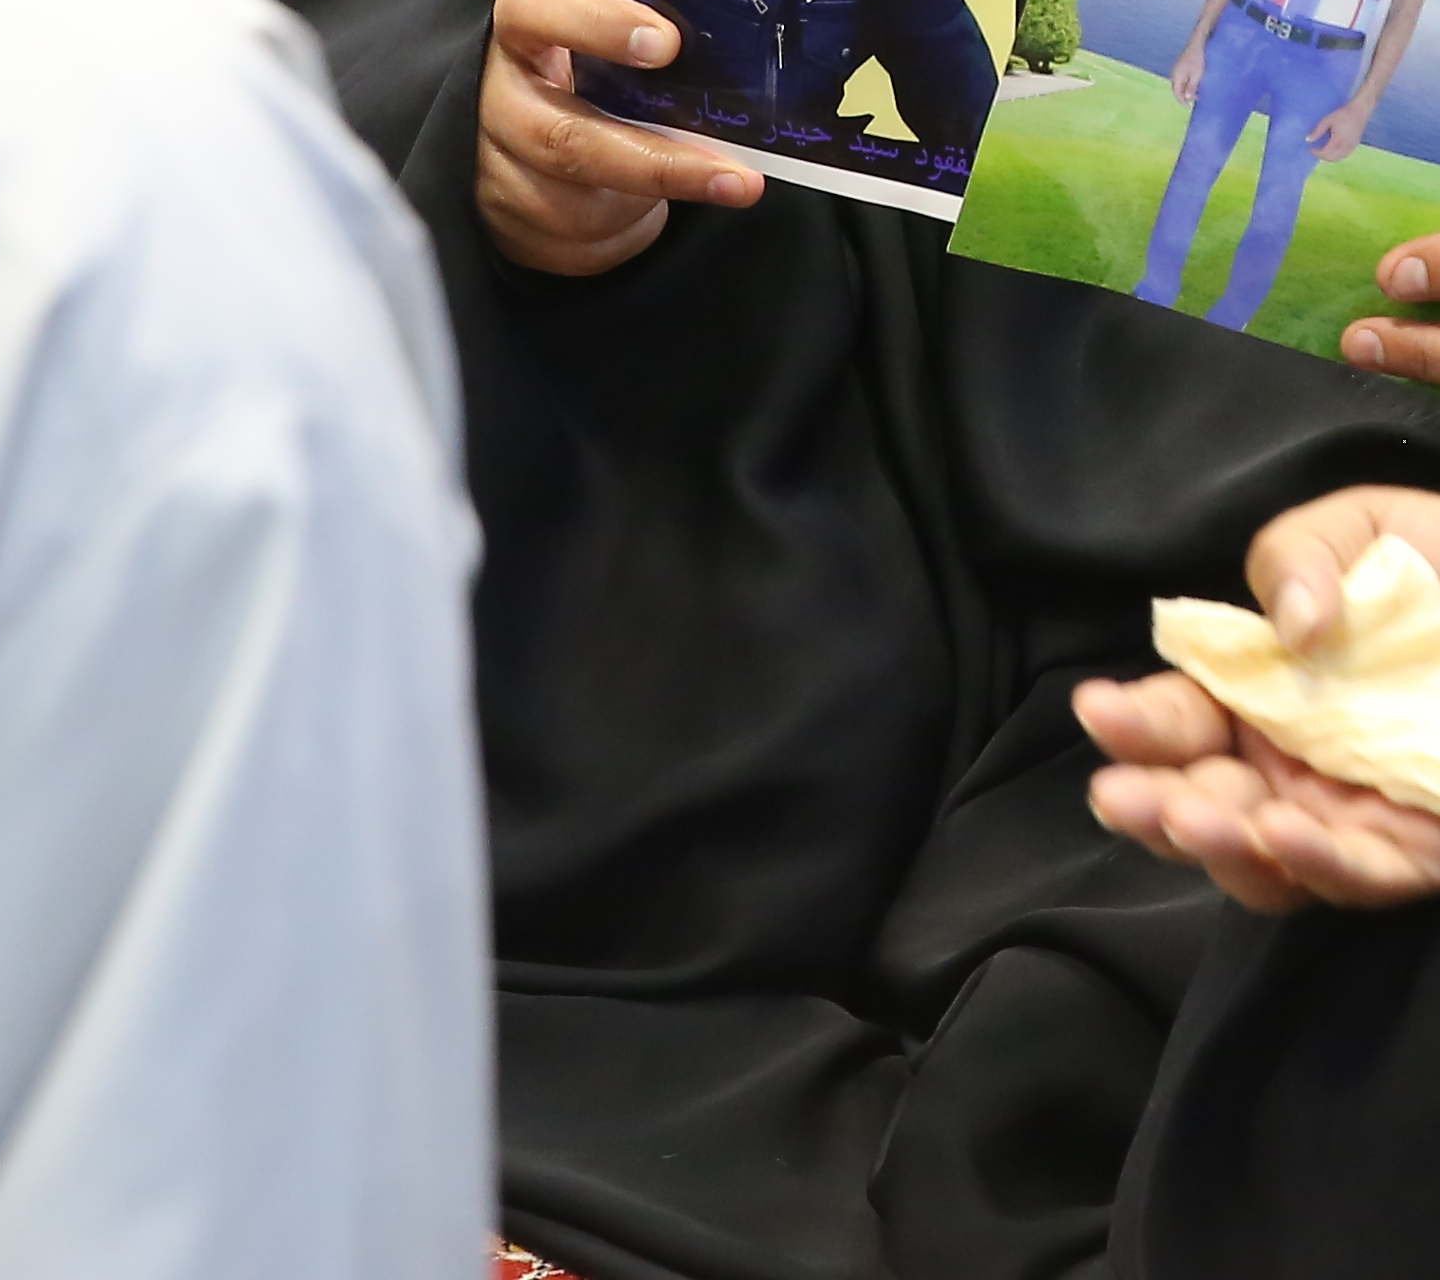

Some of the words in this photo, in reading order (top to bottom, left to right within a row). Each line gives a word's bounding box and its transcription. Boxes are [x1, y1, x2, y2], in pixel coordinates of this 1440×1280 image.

[690, 92, 750, 128] صبار
[763, 120, 834, 147] حيدر
[848, 133, 899, 162] سيد
[915, 145, 974, 181] فقود
